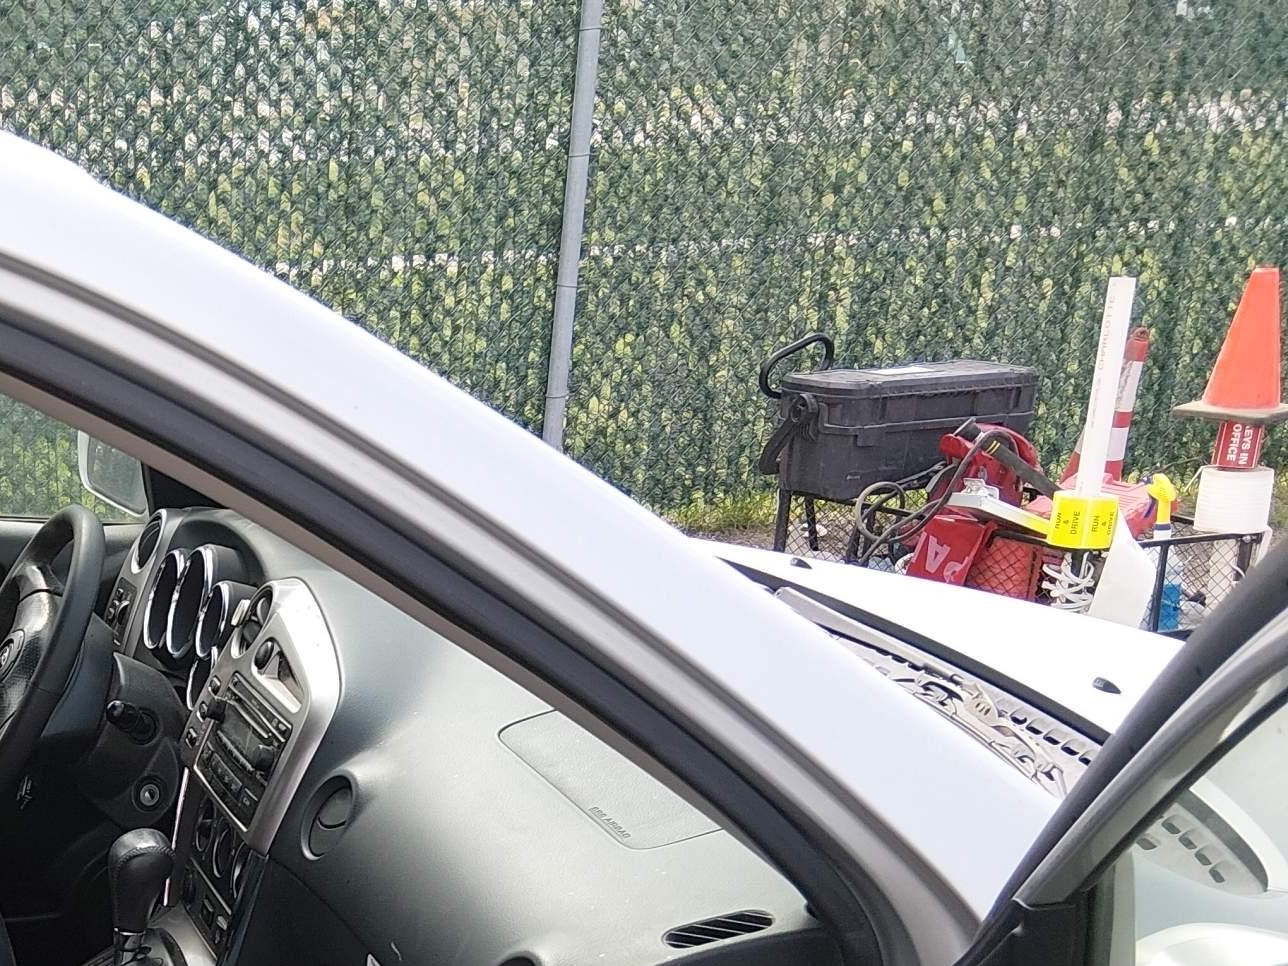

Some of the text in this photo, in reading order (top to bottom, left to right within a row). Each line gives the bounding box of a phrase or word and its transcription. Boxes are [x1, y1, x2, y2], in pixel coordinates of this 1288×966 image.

[1226, 423, 1242, 462] OFFICE
[1238, 425, 1254, 465] EYS IN
[1070, 511, 1081, 535] DRIVE
